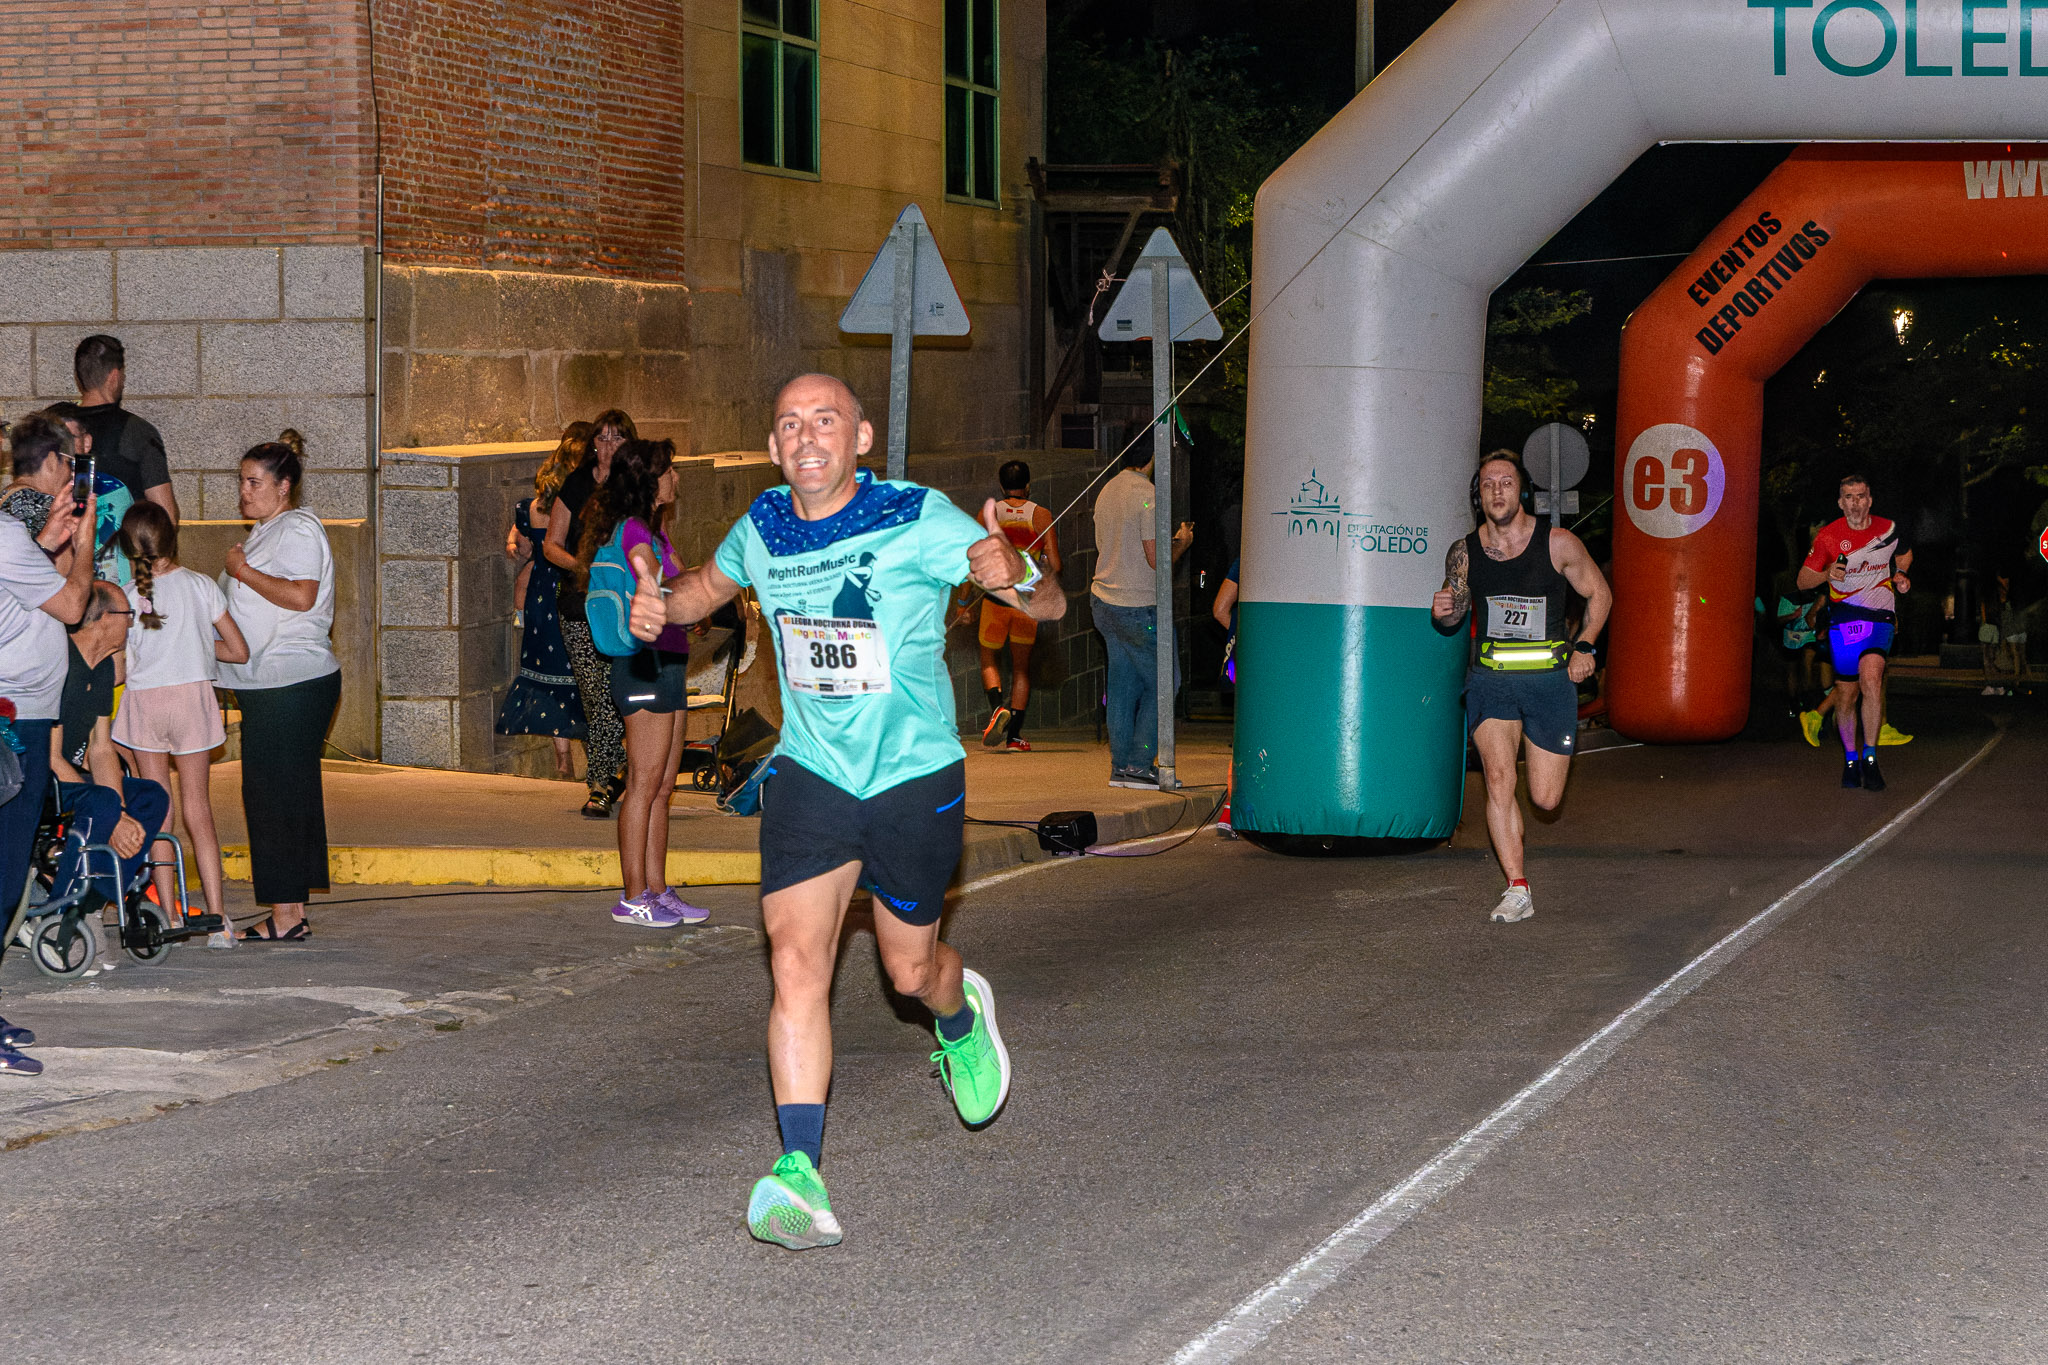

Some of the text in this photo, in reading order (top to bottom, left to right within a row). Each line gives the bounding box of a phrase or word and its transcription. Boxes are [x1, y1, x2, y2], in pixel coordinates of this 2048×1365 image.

[1963, 160, 2048, 200] WW
[1687, 211, 1782, 307] EVENTOS
[1695, 220, 1832, 356] DEPORTIVOS
[1632, 448, 1710, 516] e3
[1415, 526, 1429, 537] DE
[1347, 534, 1429, 555] TOLEDO
[813, 619, 851, 629] NOCTURNA
[1503, 609, 1528, 626] 227
[1847, 624, 1863, 635] 307
[809, 641, 858, 670] 386
